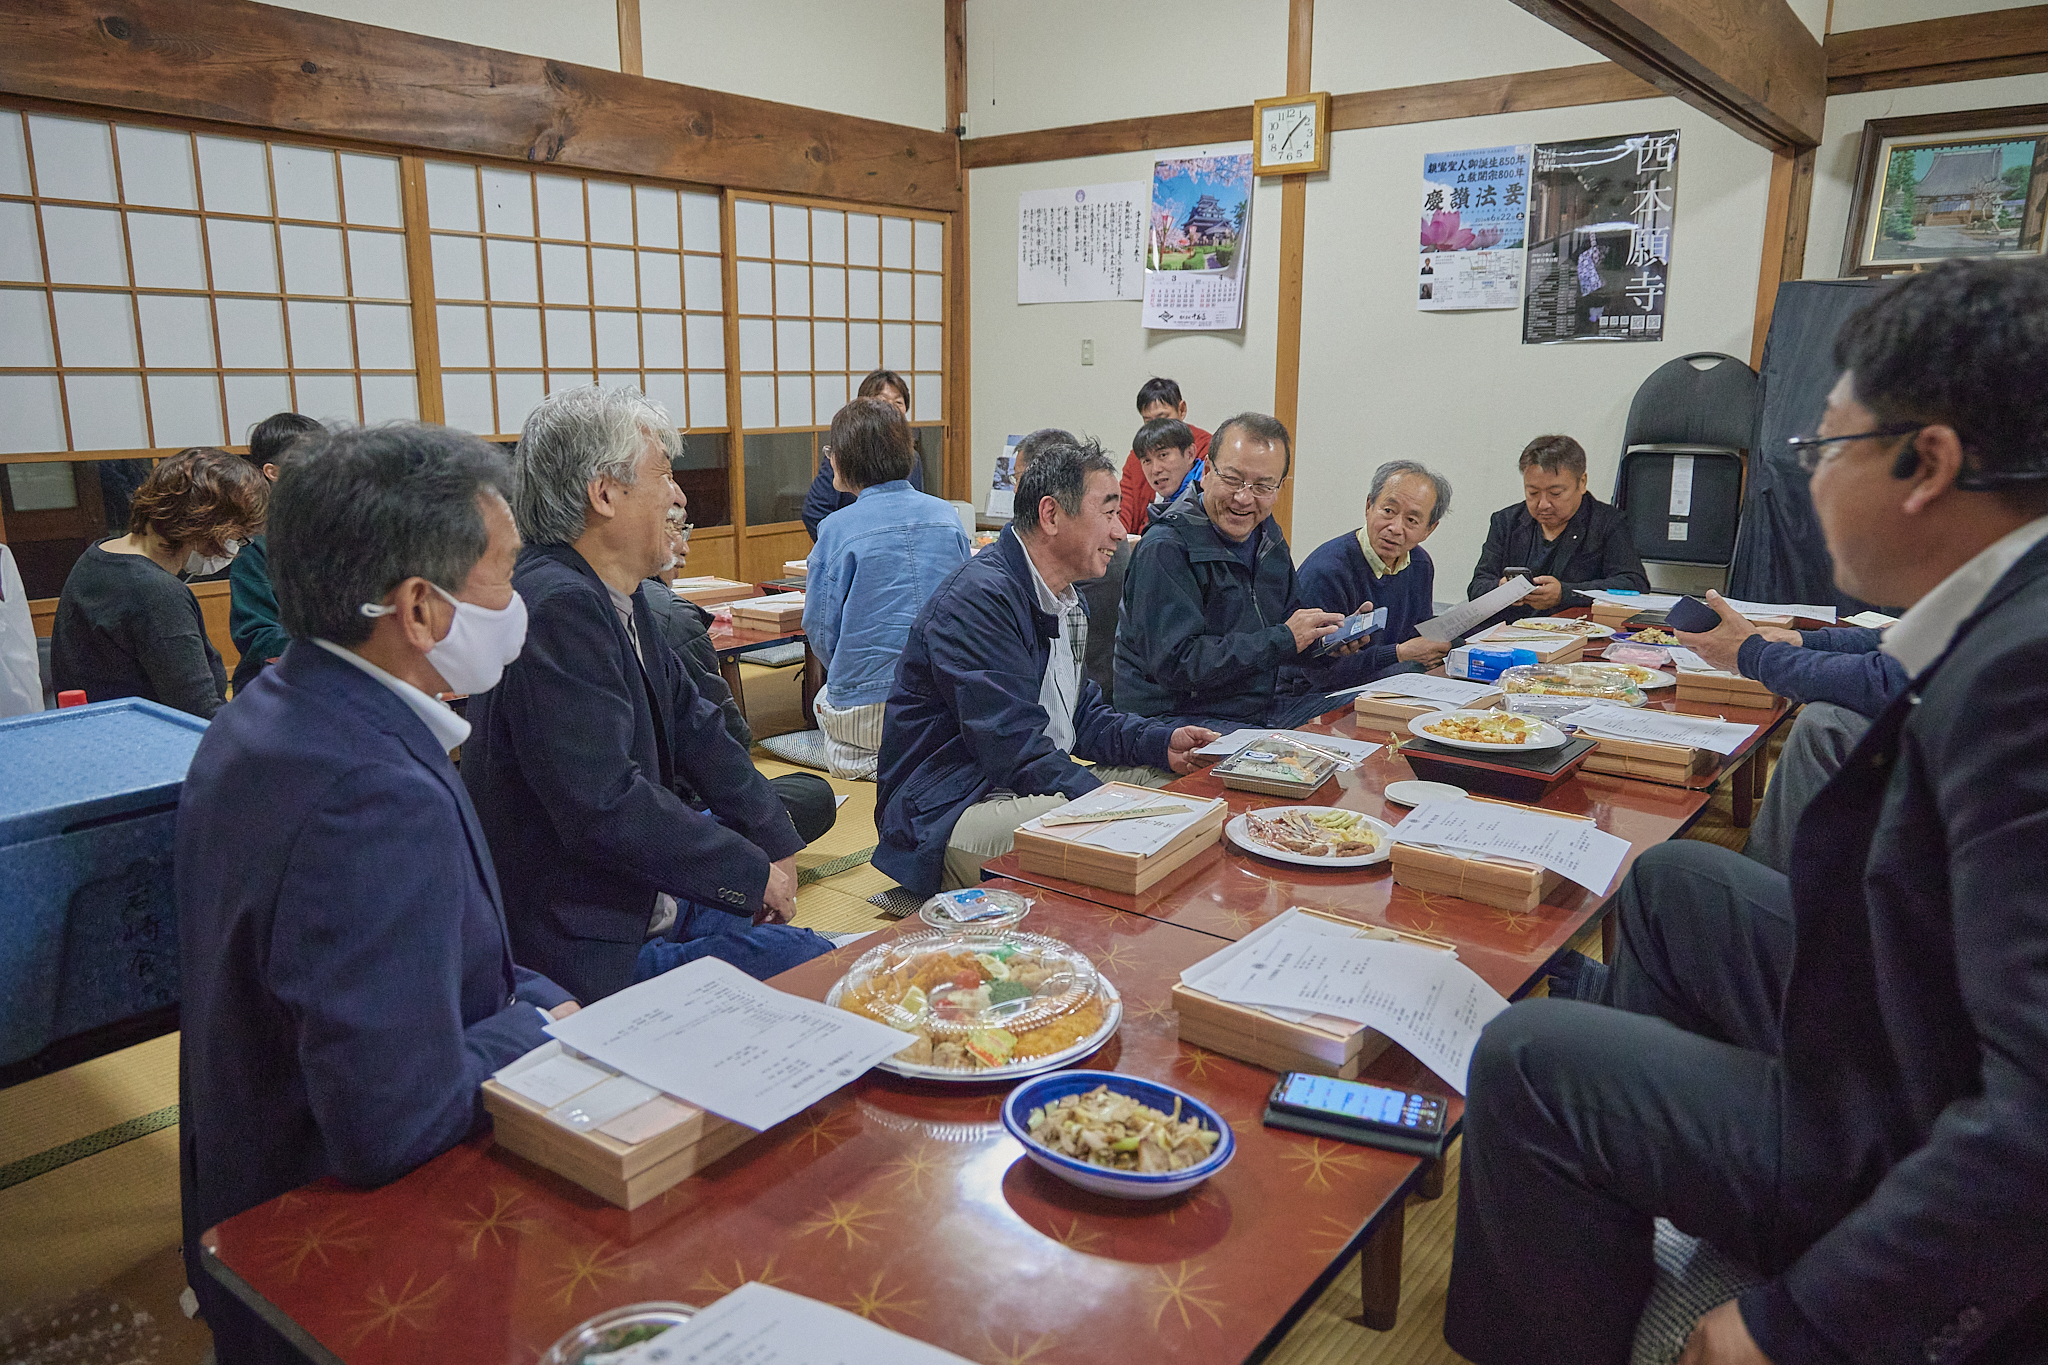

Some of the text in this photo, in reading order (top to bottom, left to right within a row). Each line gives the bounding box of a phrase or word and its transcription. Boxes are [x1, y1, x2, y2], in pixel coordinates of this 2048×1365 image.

[1278, 112, 1285, 121] 11
[1287, 108, 1295, 118] 12
[1270, 121, 1279, 131] 10
[1304, 117, 1311, 126] 2
[1268, 133, 1275, 141] 9
[1307, 128, 1313, 137] 3
[1270, 143, 1277, 152] 8
[1303, 140, 1310, 149] 4
[1278, 151, 1284, 160] 7
[1286, 152, 1293, 161] 6
[1296, 149, 1303, 158] 5
[1428, 154, 1526, 174] 親鸞聖人御誕生850年
[1625, 134, 1677, 312] 西本願寺
